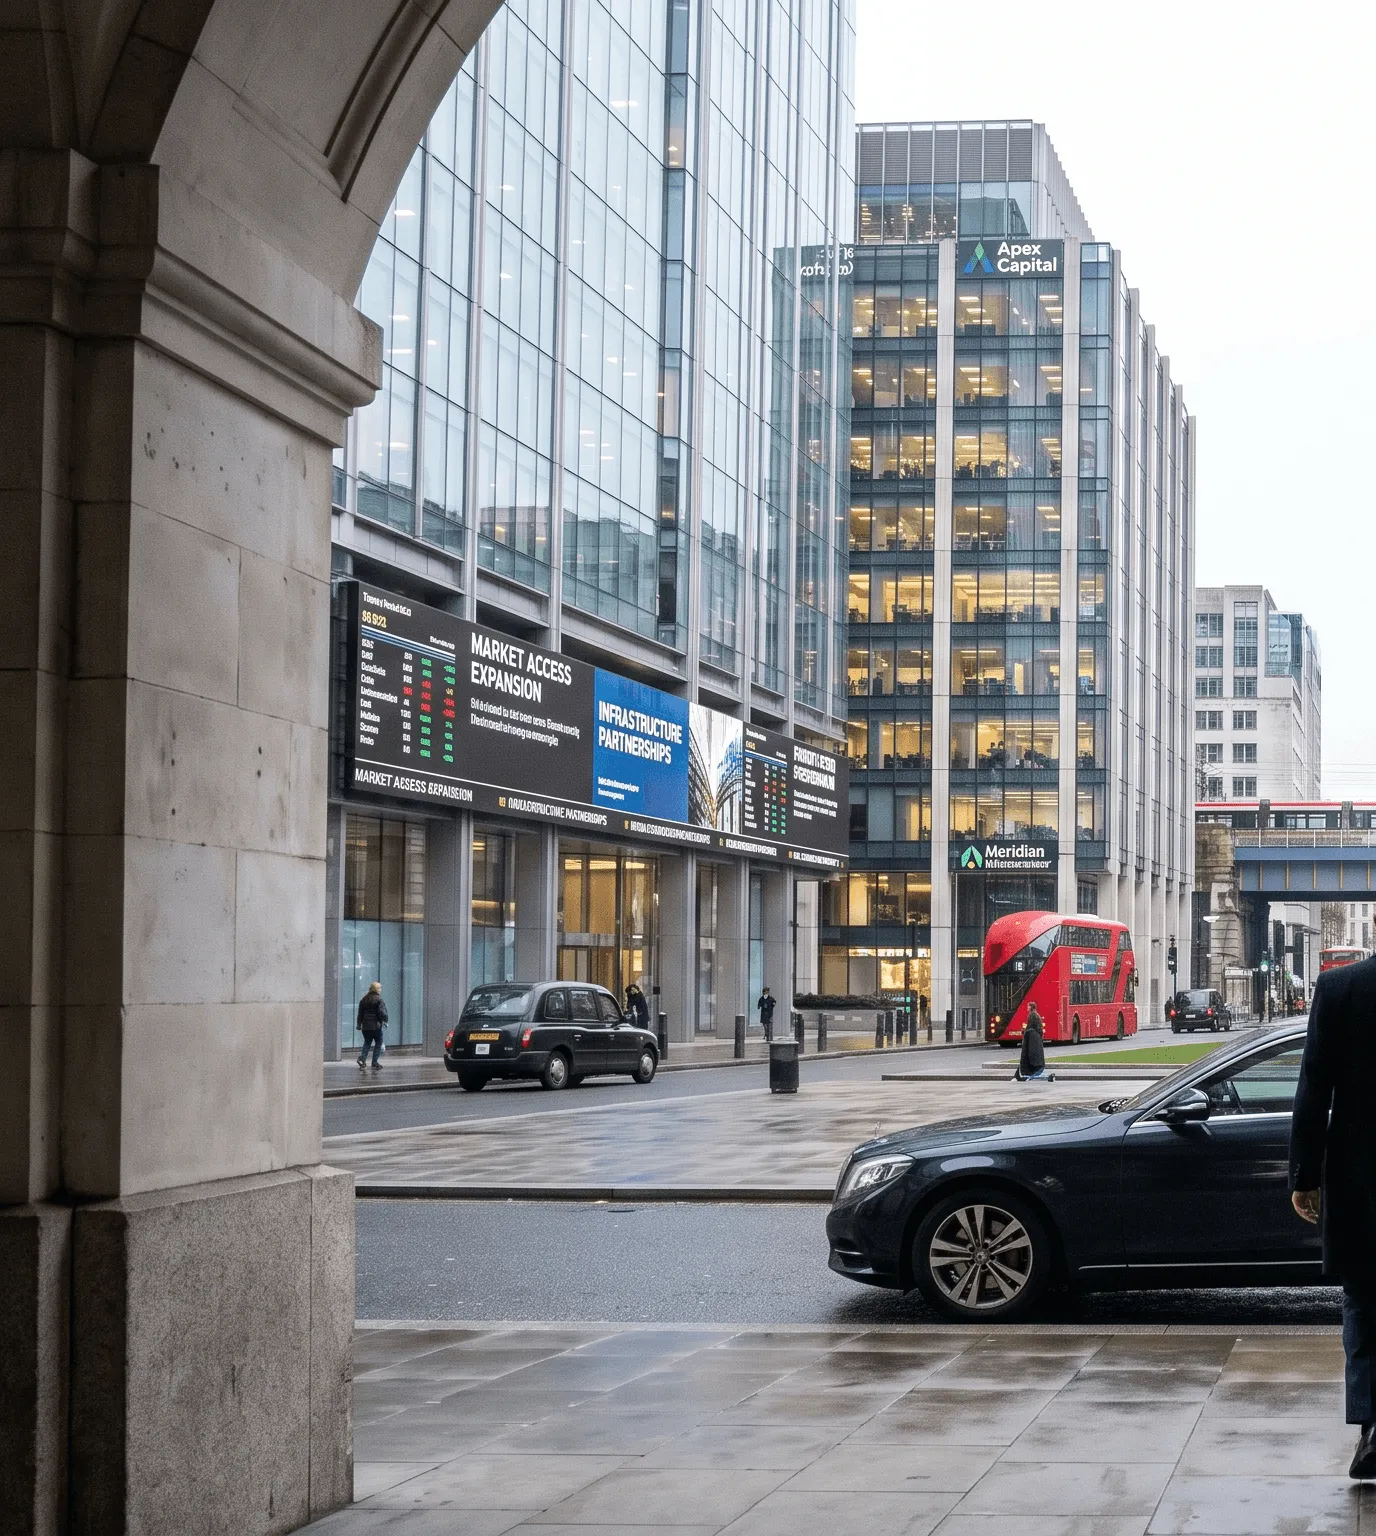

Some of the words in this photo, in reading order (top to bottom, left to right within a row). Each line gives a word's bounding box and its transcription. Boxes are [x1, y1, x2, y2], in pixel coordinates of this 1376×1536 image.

[997, 241, 1041, 259] Apex
[997, 257, 1057, 276] Capital
[471, 632, 524, 669] MARKET
[526, 652, 572, 686] ACCESS
[471, 661, 542, 703] EXPANSION
[598, 700, 683, 745] INFRASTRUCTURE
[598, 725, 672, 765] PARTNERSHIPS
[354, 768, 393, 787] MARKET
[985, 844, 1045, 858] Meridian
